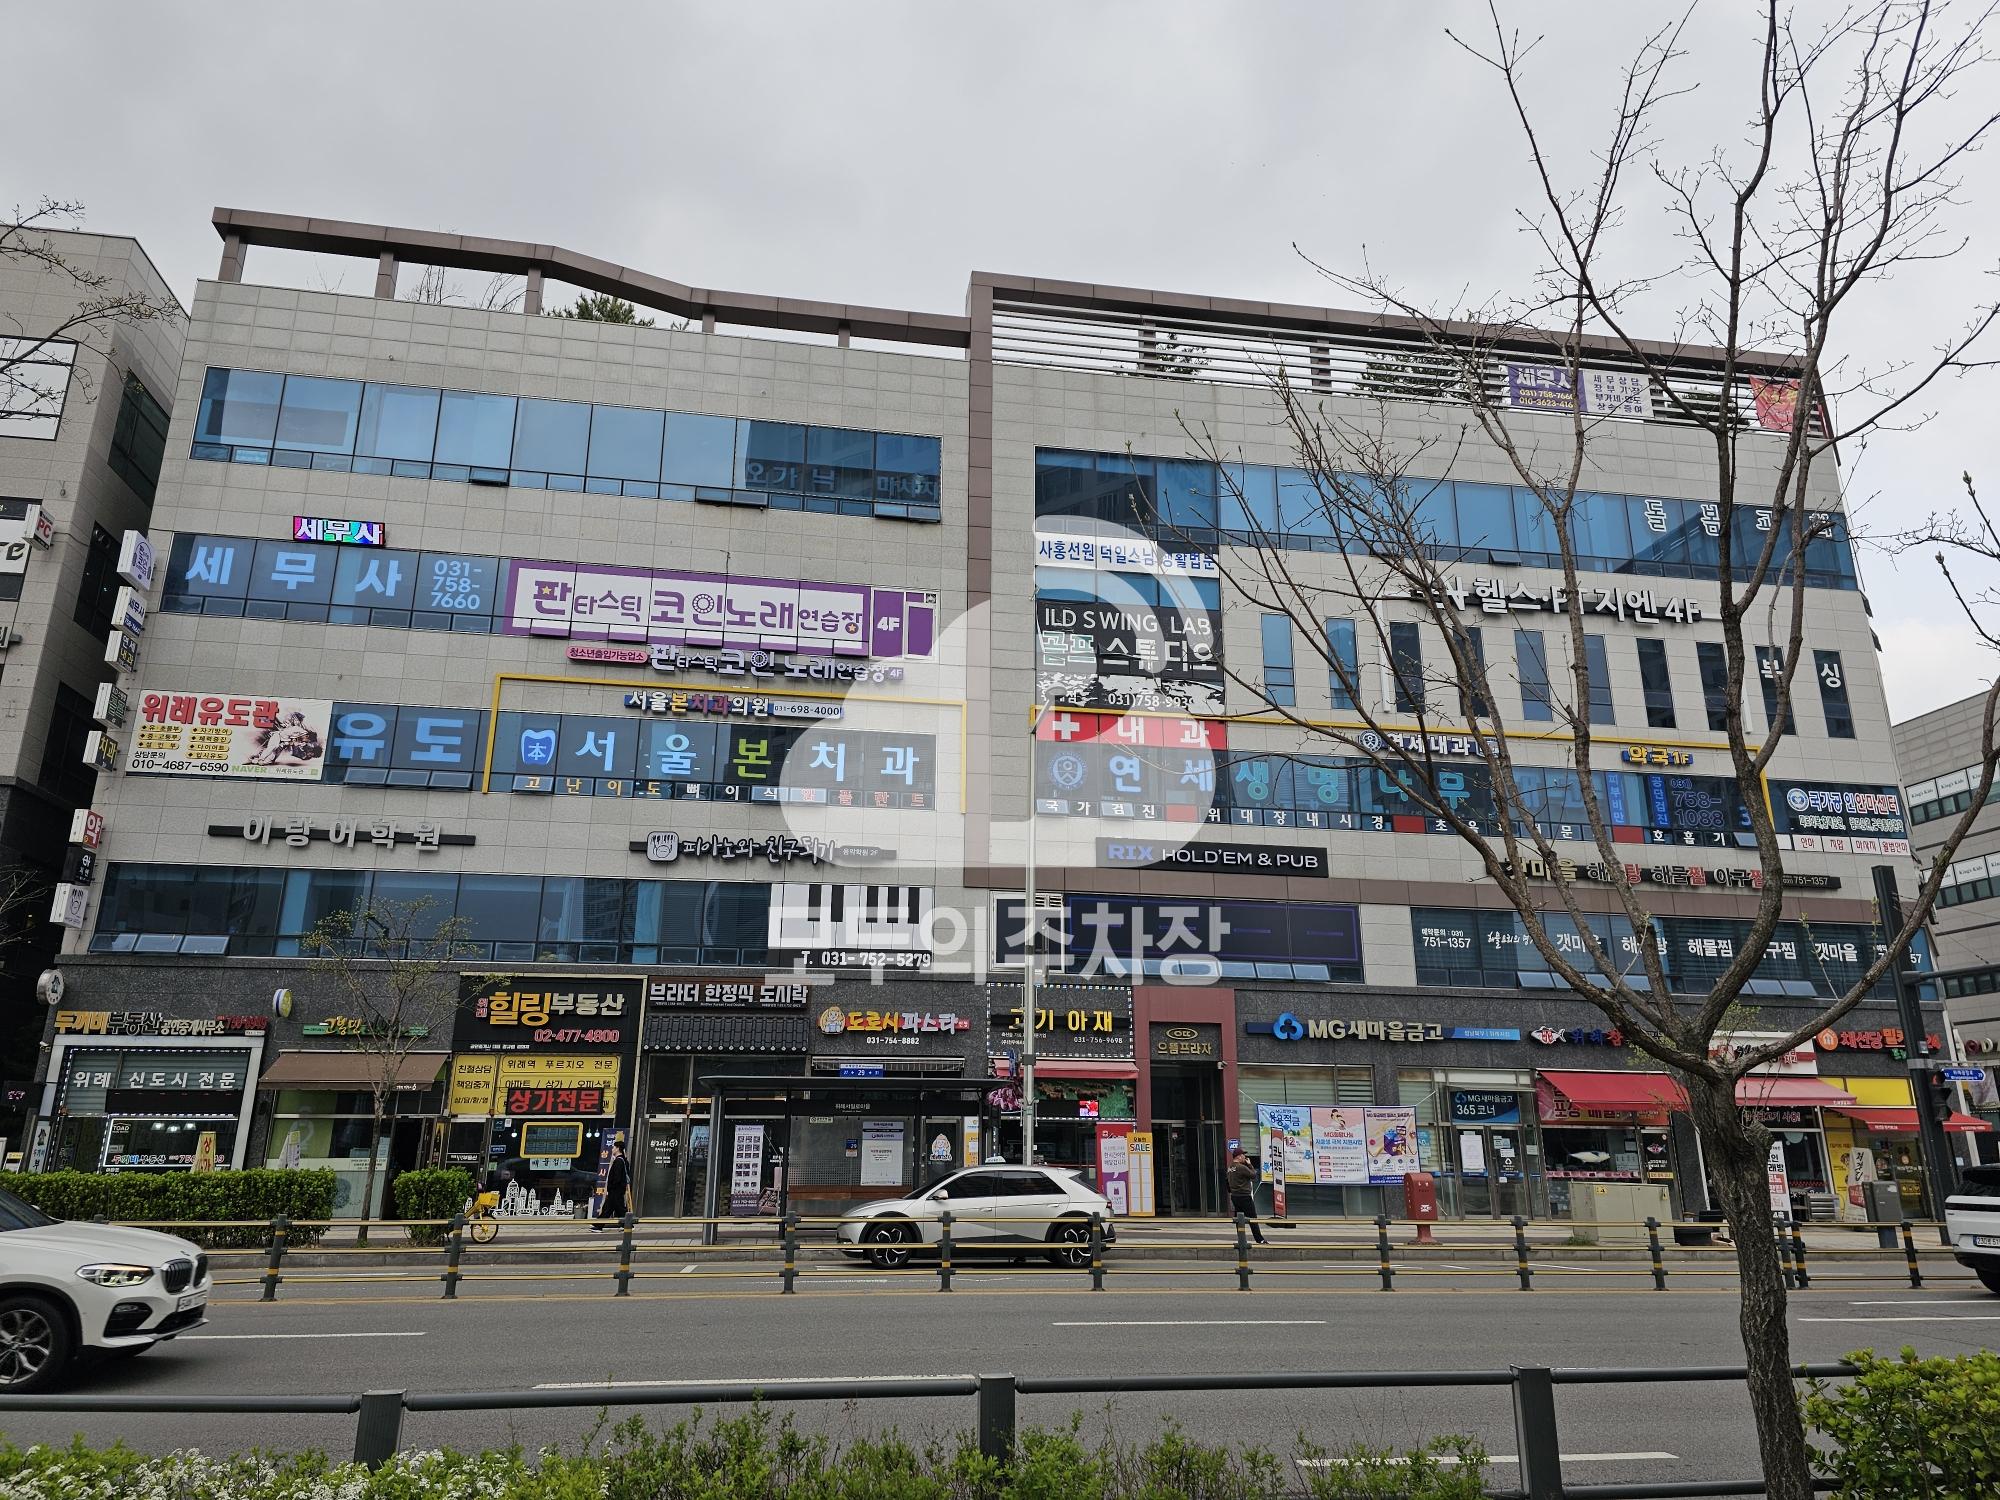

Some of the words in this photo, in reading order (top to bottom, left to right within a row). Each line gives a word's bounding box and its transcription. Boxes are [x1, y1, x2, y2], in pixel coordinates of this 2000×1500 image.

[36, 517, 52, 540] PC
[294, 516, 384, 545] 세무사
[1039, 539, 1095, 562] 사홍선원
[1100, 544, 1157, 566] 덕일스님
[184, 545, 403, 597] 세무사
[433, 559, 483, 576] 031-
[432, 575, 481, 592] 758-
[430, 591, 481, 611] 7660
[533, 579, 643, 624] 판타스틱
[876, 616, 901, 633] 4F
[1594, 587, 1660, 626] 지엔
[1664, 597, 1703, 624] 4F
[1170, 616, 1212, 635] LAB
[1042, 630, 1097, 667] 골프
[1102, 637, 1218, 673] 스튜디오
[628, 690, 771, 718] 서울본치과의원
[773, 703, 841, 718] 031-698-4000
[333, 711, 463, 763] 유도
[1117, 715, 1210, 748] 내과
[98, 736, 118, 761] 치과
[134, 750, 167, 760] 상담문의
[1387, 731, 1470, 757] 연세내과
[1627, 744, 1670, 767] 약국
[1671, 750, 1691, 766] 1F
[131, 758, 229, 773] 010-4687-6590
[231, 765, 268, 775] NAVER
[575, 731, 920, 786] 서울본치과
[1109, 755, 1213, 794] 연세
[523, 776, 662, 798] 고난이도
[686, 782, 780, 801] 뼈이식
[1608, 775, 1625, 824] 피부비만
[1671, 790, 1722, 808] 758-
[1651, 776, 1668, 825] 공단검진
[1045, 800, 1156, 820] 국가검진
[1207, 807, 1384, 831] 위대장내시경
[1674, 809, 1724, 828] 1088
[84, 811, 104, 849] 약
[243, 814, 442, 852] 이랑어학원
[1652, 829, 1727, 847] 호흡기
[683, 837, 760, 860] 피아노와
[1106, 843, 1154, 861] RIX
[1161, 848, 1254, 866] HOLD'EM
[1256, 854, 1273, 867] &
[1276, 854, 1319, 868] PUB
[1650, 864, 1707, 886] 해물찜
[1793, 876, 1829, 886] 751-1357
[1422, 936, 1471, 949] 751-1357
[1687, 938, 1733, 958] 해물찜
[1814, 942, 1858, 963] 갯마을
[650, 983, 700, 1002] 브라더
[704, 984, 755, 1003] 한정식
[759, 984, 809, 1005] 도시락
[1067, 1008, 1113, 1034] 아재
[1308, 1019, 1346, 1040] MG
[1348, 1020, 1445, 1042] 새마을금고
[866, 1035, 920, 1046] 031-754-8882
[1073, 1035, 1124, 1045] 031-756-9698
[1157, 1042, 1213, 1056] 으뜸프라자
[1840, 1031, 1884, 1050] 채선당
[457, 1064, 493, 1075] 친절상담
[507, 1059, 536, 1070] 위례역
[545, 1059, 586, 1070] 푸르지오
[594, 1060, 613, 1071] 전문
[73, 1071, 112, 1089] 위례
[129, 1071, 188, 1089] 신도시
[198, 1072, 236, 1090] 전문
[509, 1088, 601, 1113] 상가전문
[1456, 1104, 1476, 1115] 365
[1477, 1104, 1496, 1116] 코너
[1467, 1094, 1481, 1103] MG
[1129, 1143, 1151, 1152] SALE
